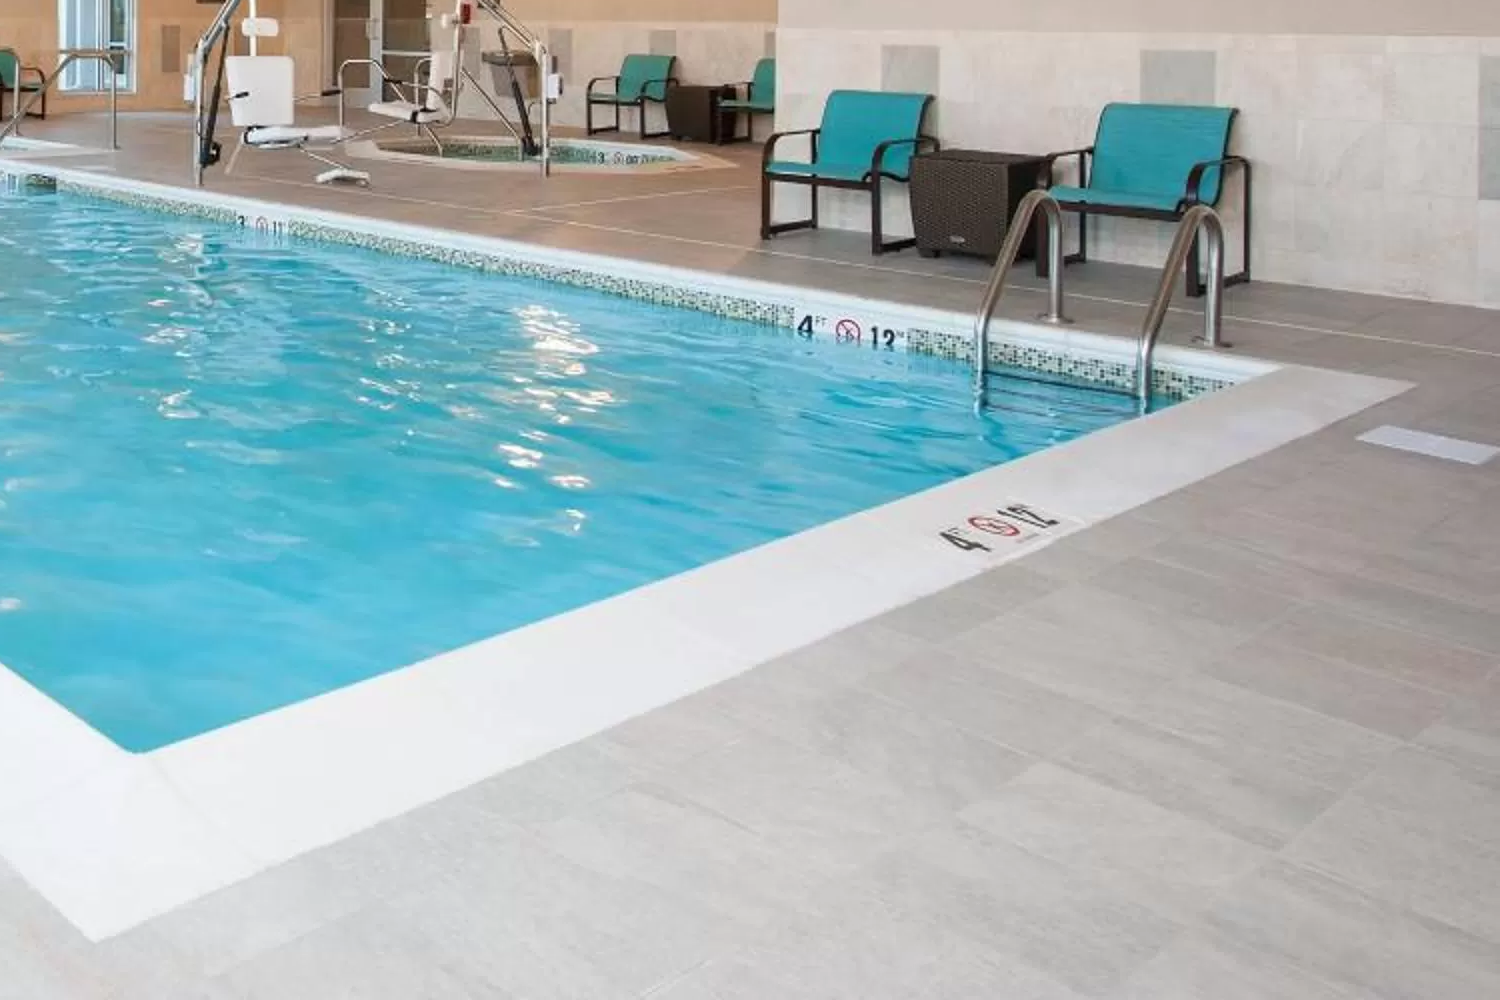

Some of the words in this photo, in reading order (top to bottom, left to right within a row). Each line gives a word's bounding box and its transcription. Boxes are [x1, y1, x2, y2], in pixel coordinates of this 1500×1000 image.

[797, 315, 813, 332] 4
[871, 325, 896, 346] 12
[939, 532, 992, 552] 4
[996, 504, 1059, 529] 12
